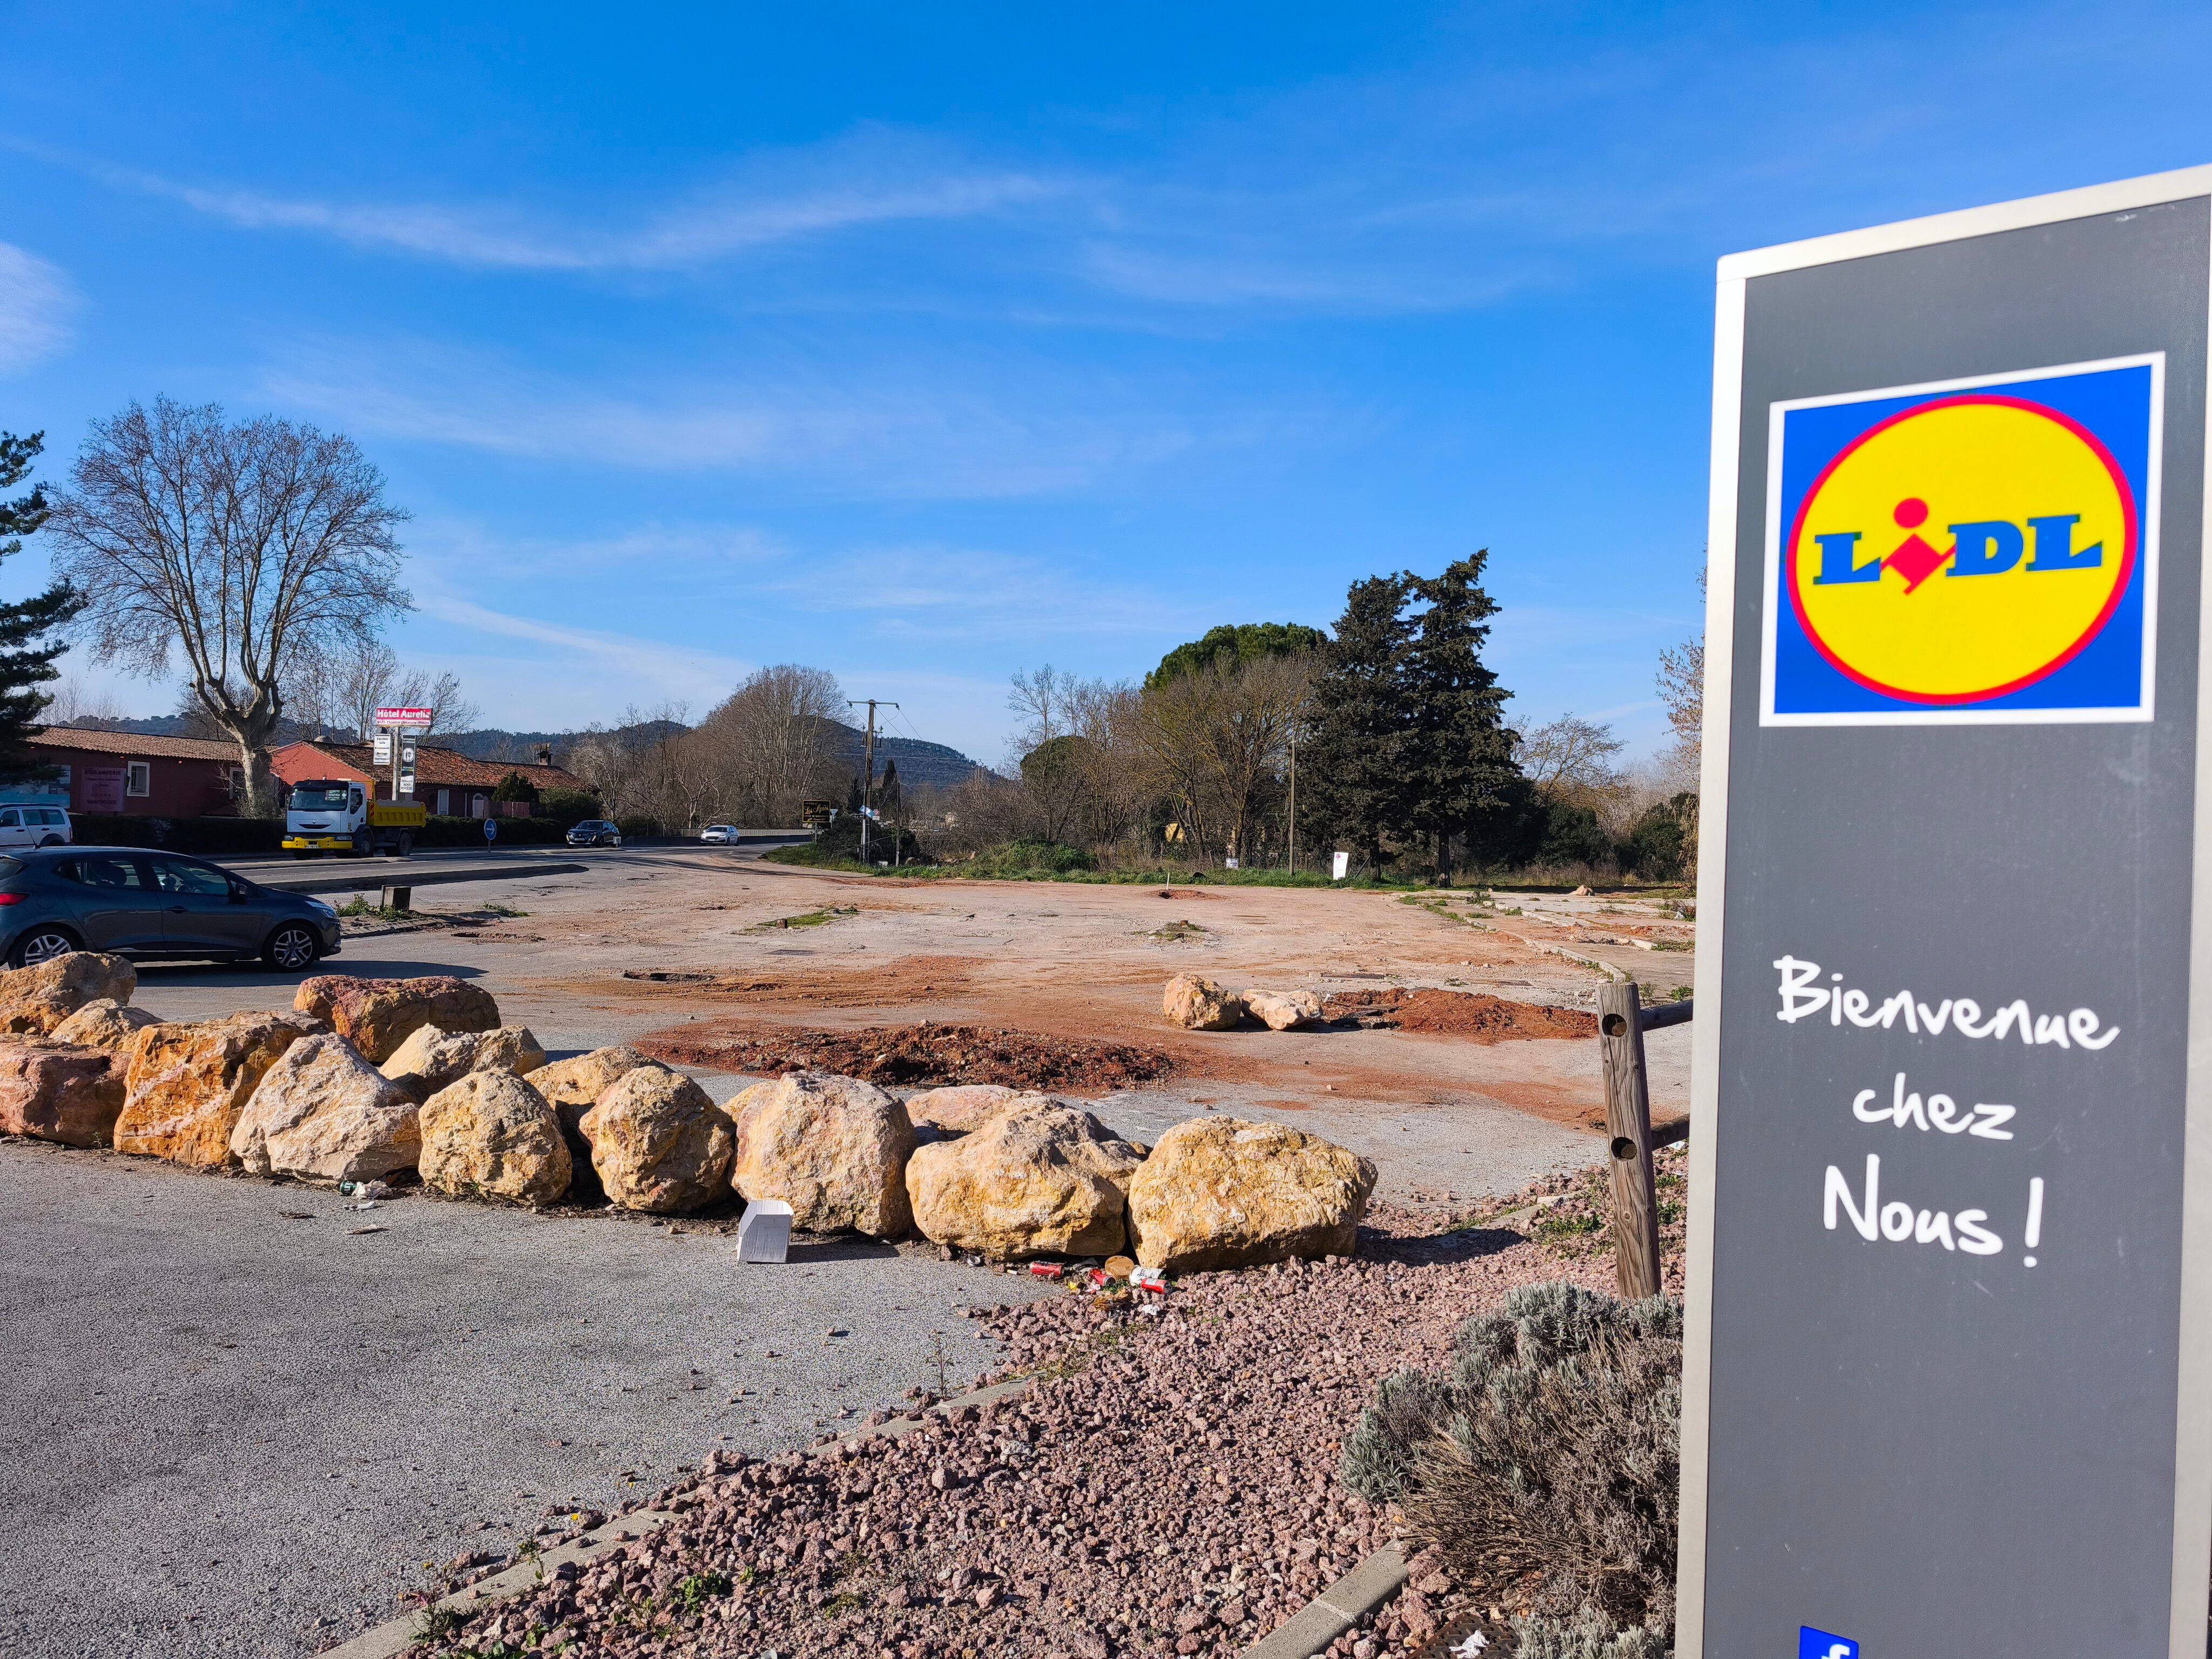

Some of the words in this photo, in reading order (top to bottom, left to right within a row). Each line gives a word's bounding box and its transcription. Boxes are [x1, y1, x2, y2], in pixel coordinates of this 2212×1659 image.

[1773, 955, 2121, 1050] Bienvenue
[1852, 1072, 2017, 1140] chez
[1823, 1154, 2003, 1256] Nous
